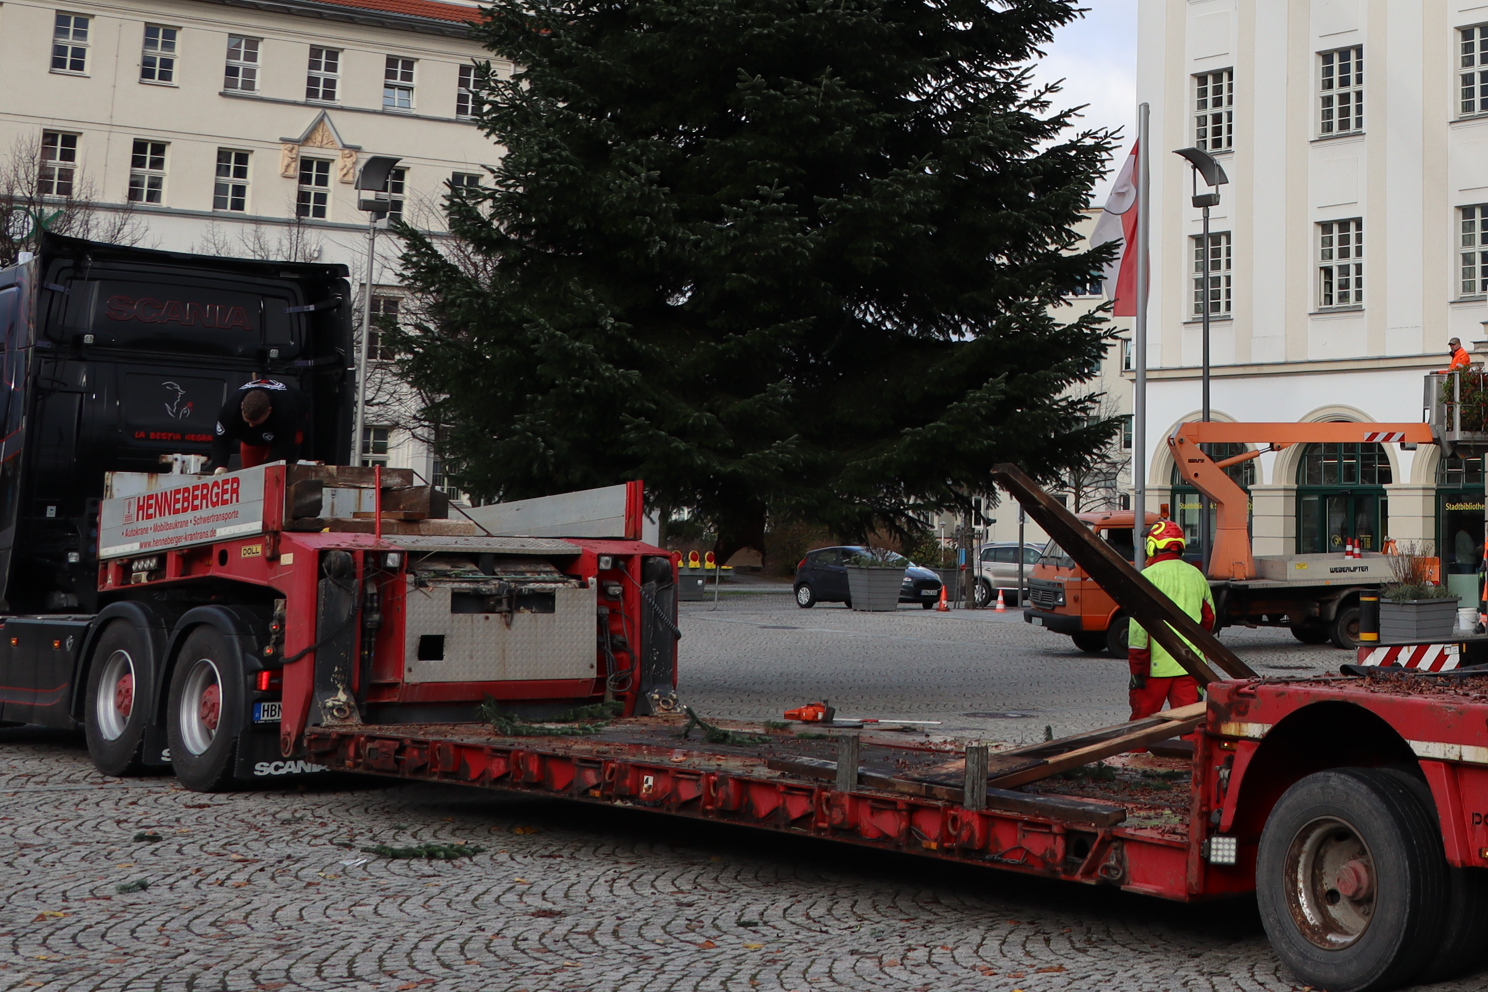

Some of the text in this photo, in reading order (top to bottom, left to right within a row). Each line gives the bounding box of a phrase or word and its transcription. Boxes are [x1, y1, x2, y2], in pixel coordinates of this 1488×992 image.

[106, 295, 252, 331] SCANIA
[149, 431, 182, 441] BESTIA
[185, 433, 214, 442] NEGRA
[135, 476, 241, 522] HENNEBERGER
[124, 509, 239, 538] Autokrane Mobilbaukrane Schwertransporte
[139, 528, 217, 549] www.henneberger-krantrans.de
[243, 546, 260, 556] DOLL
